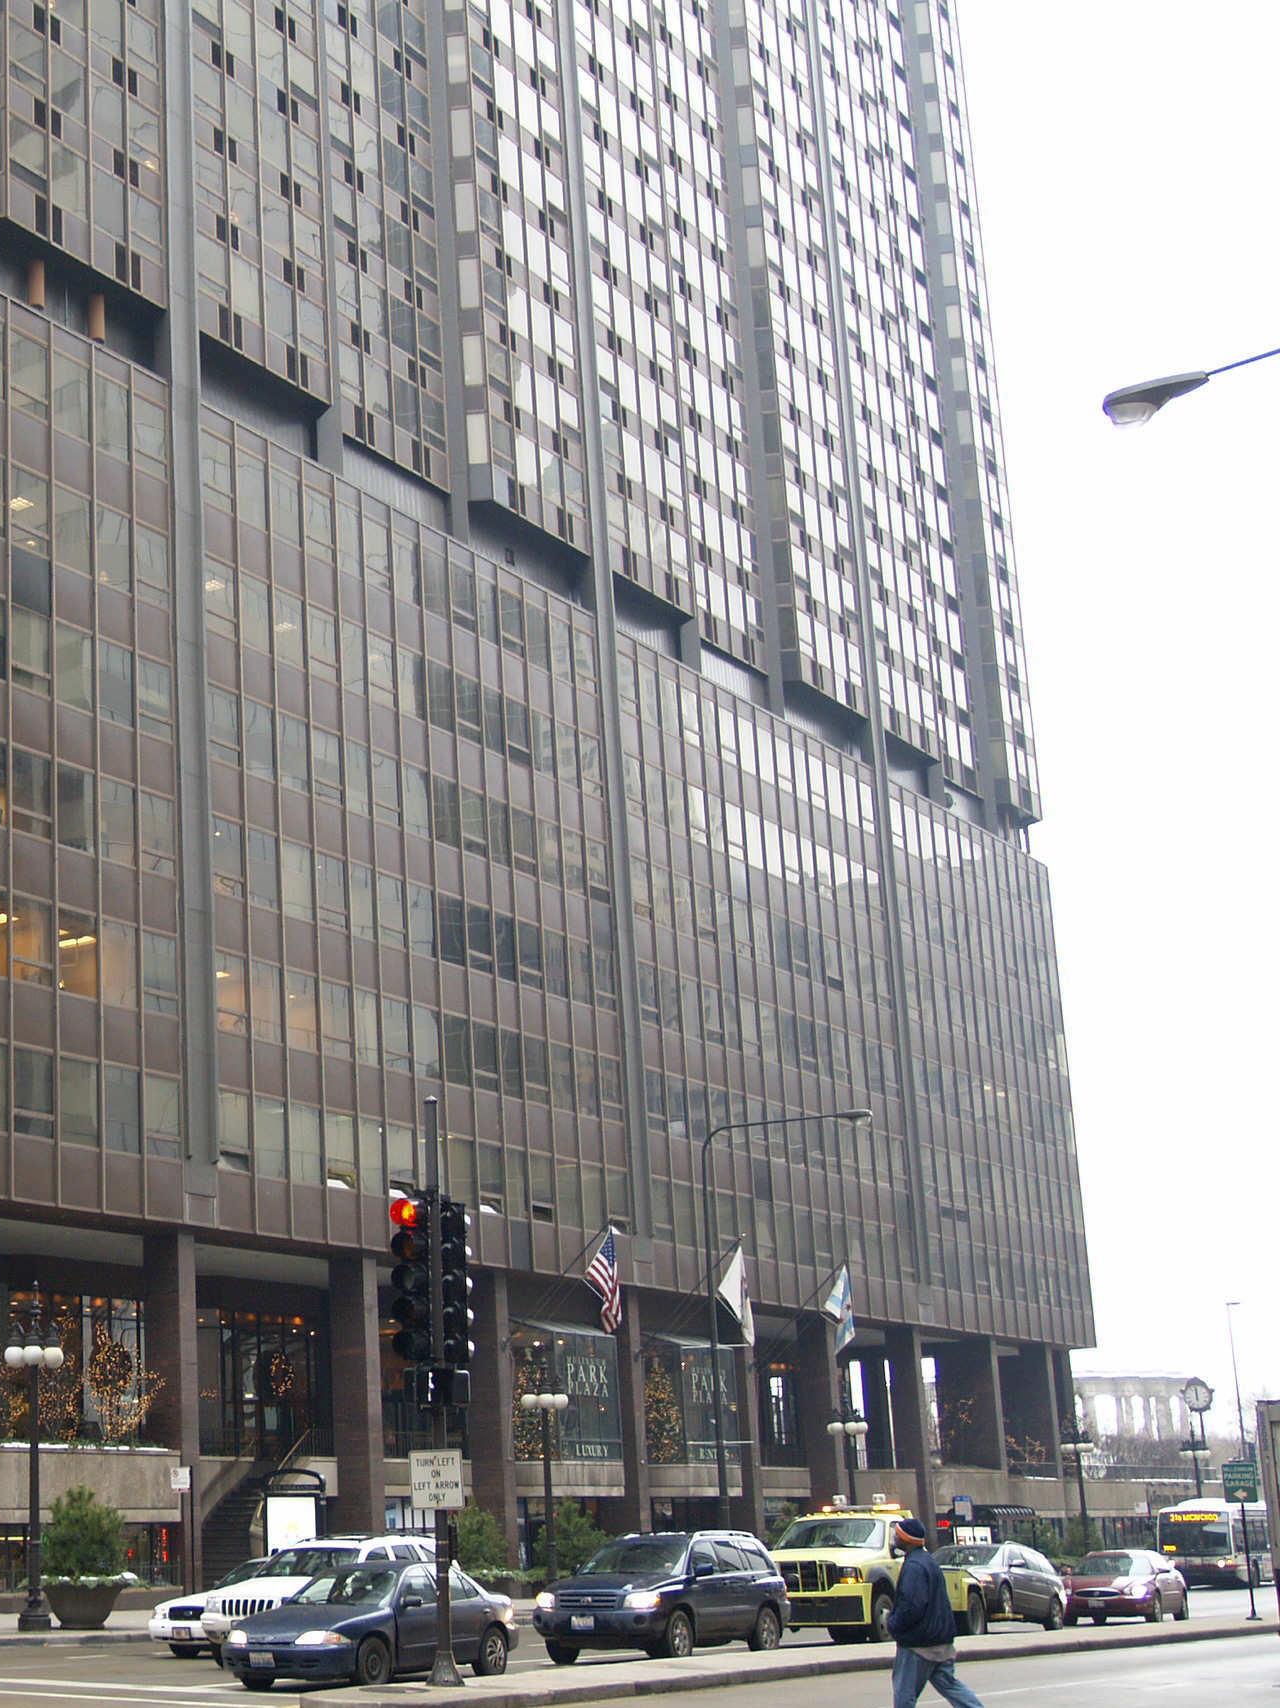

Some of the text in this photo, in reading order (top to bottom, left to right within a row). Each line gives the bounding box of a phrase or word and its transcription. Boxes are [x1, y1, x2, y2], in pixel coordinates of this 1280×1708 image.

[567, 1363, 608, 1384] PARK
[568, 1381, 609, 1398] PLAZA
[692, 1389, 727, 1405] PLAA
[576, 1443, 608, 1457] LUXURY
[416, 1456, 455, 1467] TURN LEFT
[431, 1469, 440, 1478] ON
[413, 1480, 459, 1490] LEFT ARROW
[428, 1493, 446, 1501] ONLY
